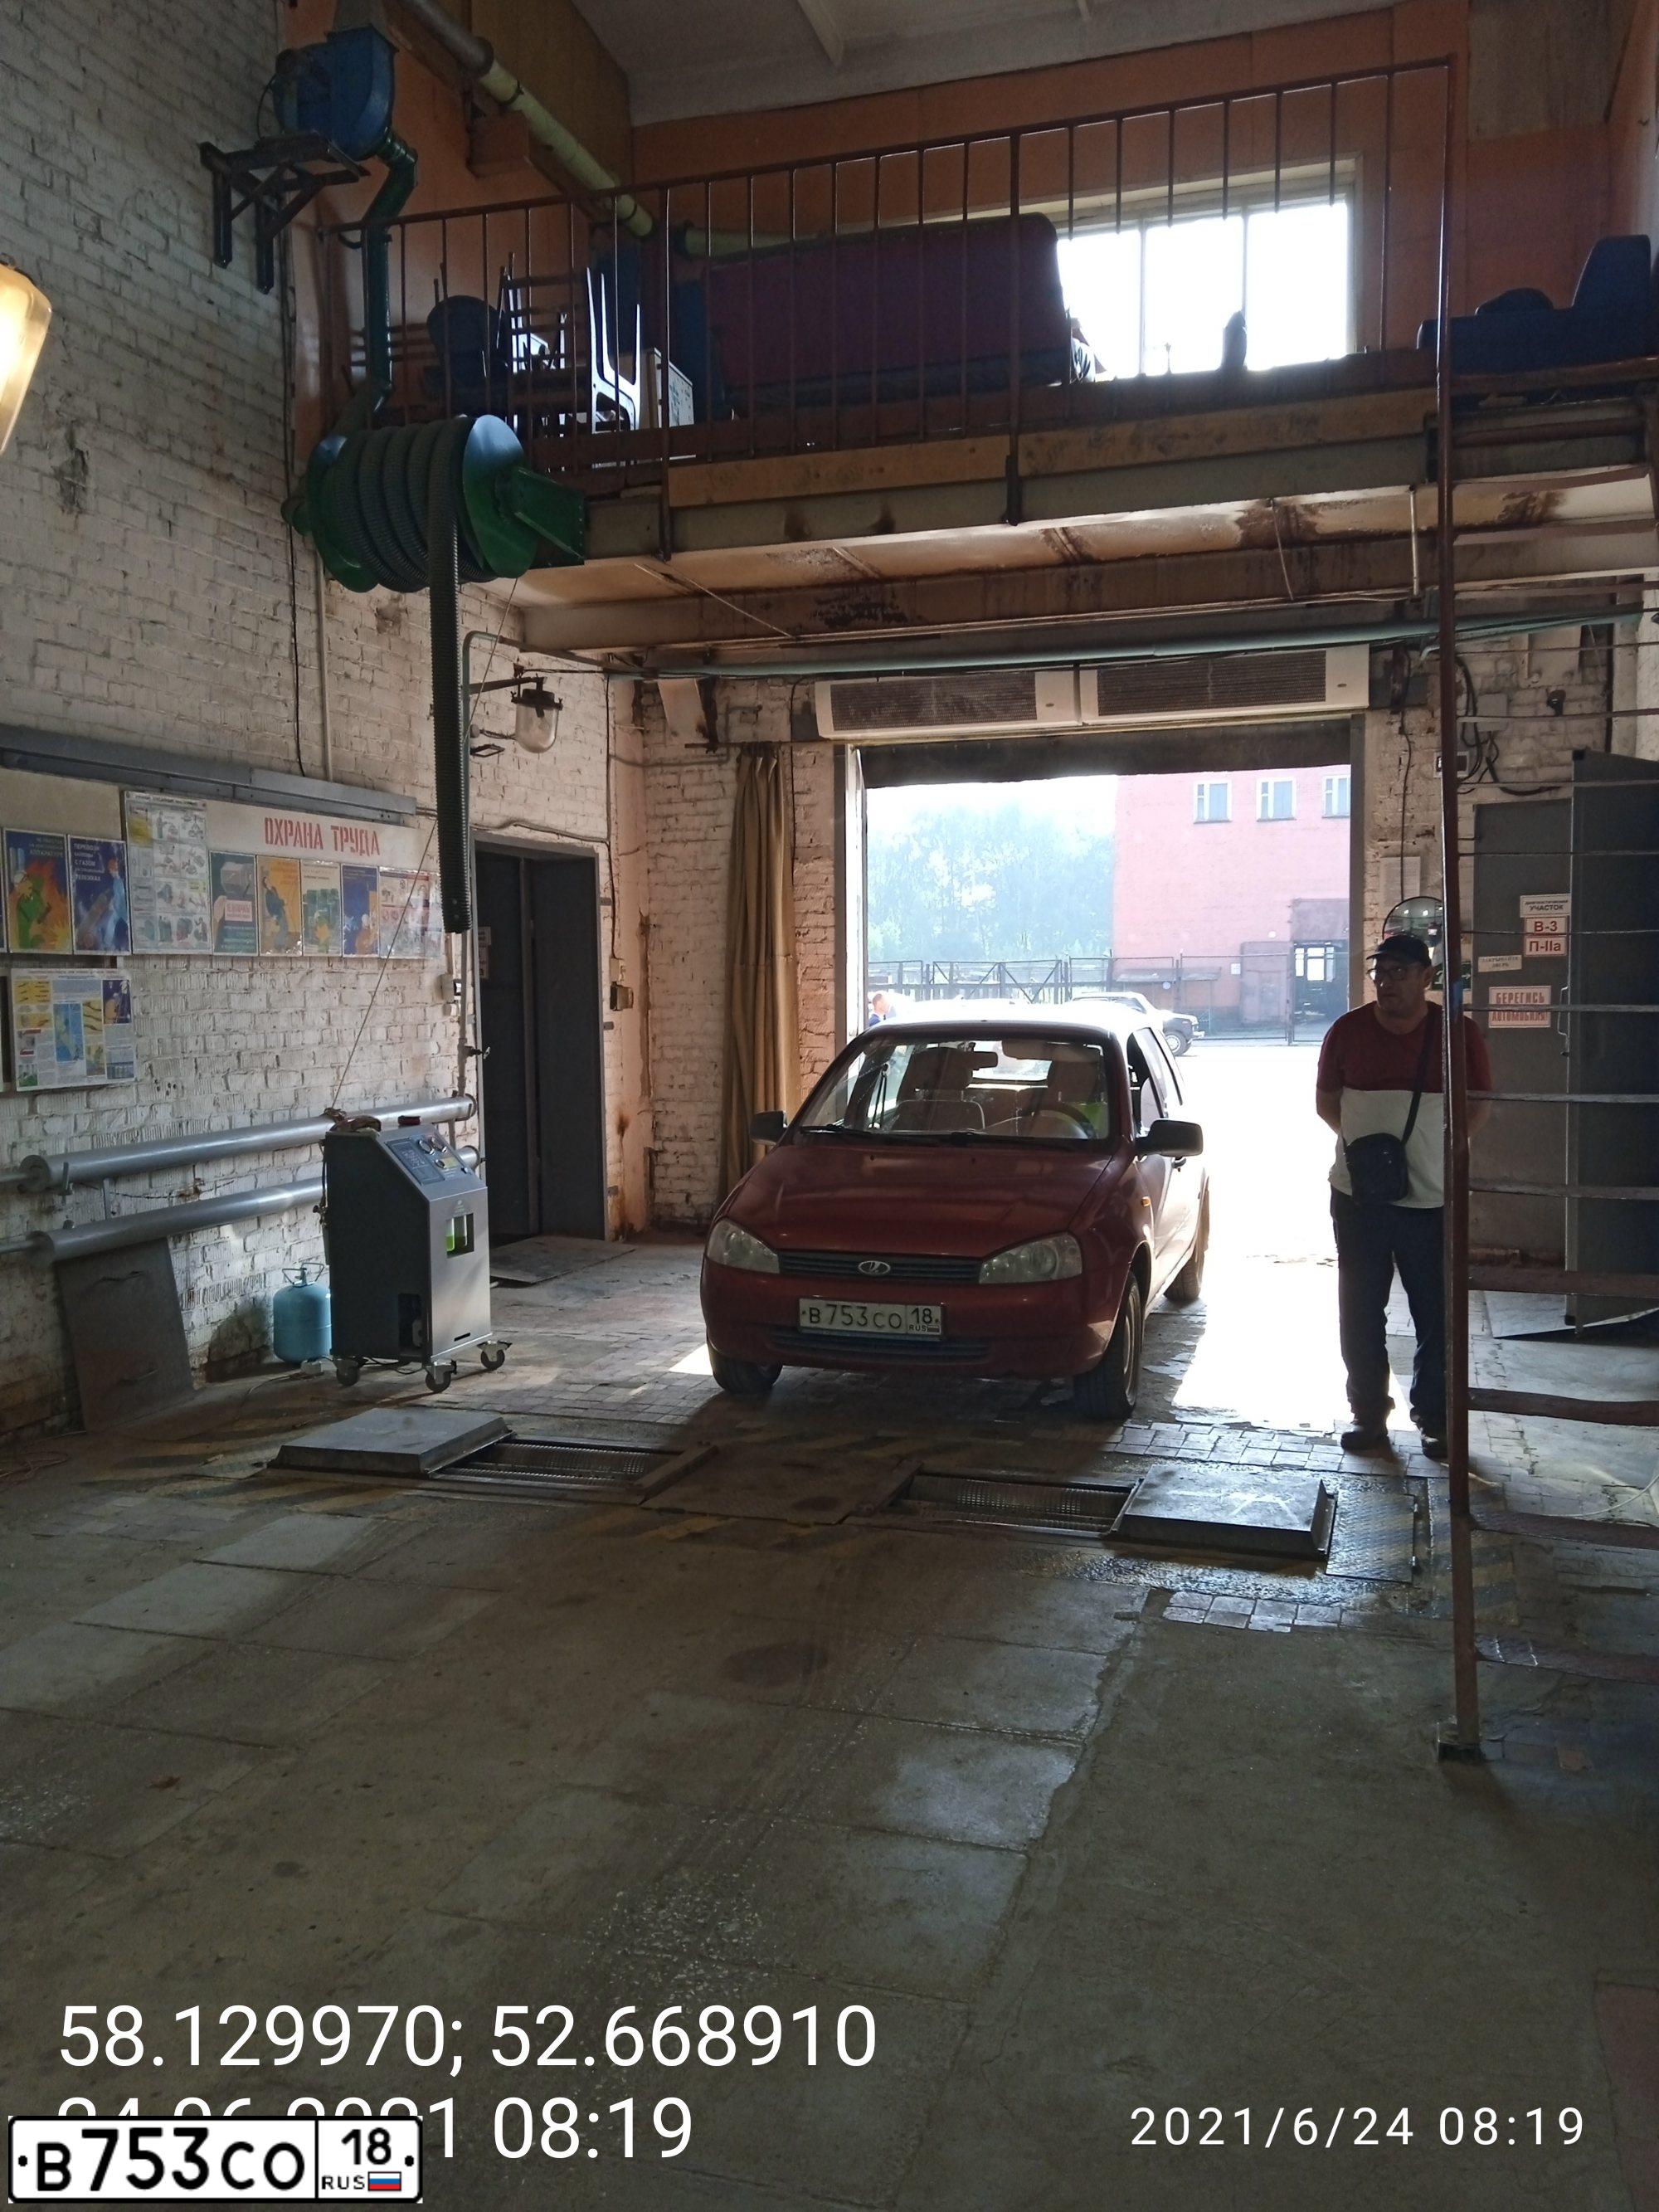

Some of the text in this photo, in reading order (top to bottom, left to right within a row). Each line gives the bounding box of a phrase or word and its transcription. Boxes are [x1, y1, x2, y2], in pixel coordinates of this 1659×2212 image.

[264, 816, 381, 856] ОХРАНА ТРУДА
[1535, 920, 1558, 932] В-3
[1495, 992, 1545, 1004] БЕРЕГИСЬ
[911, 1308, 932, 1324] 18
